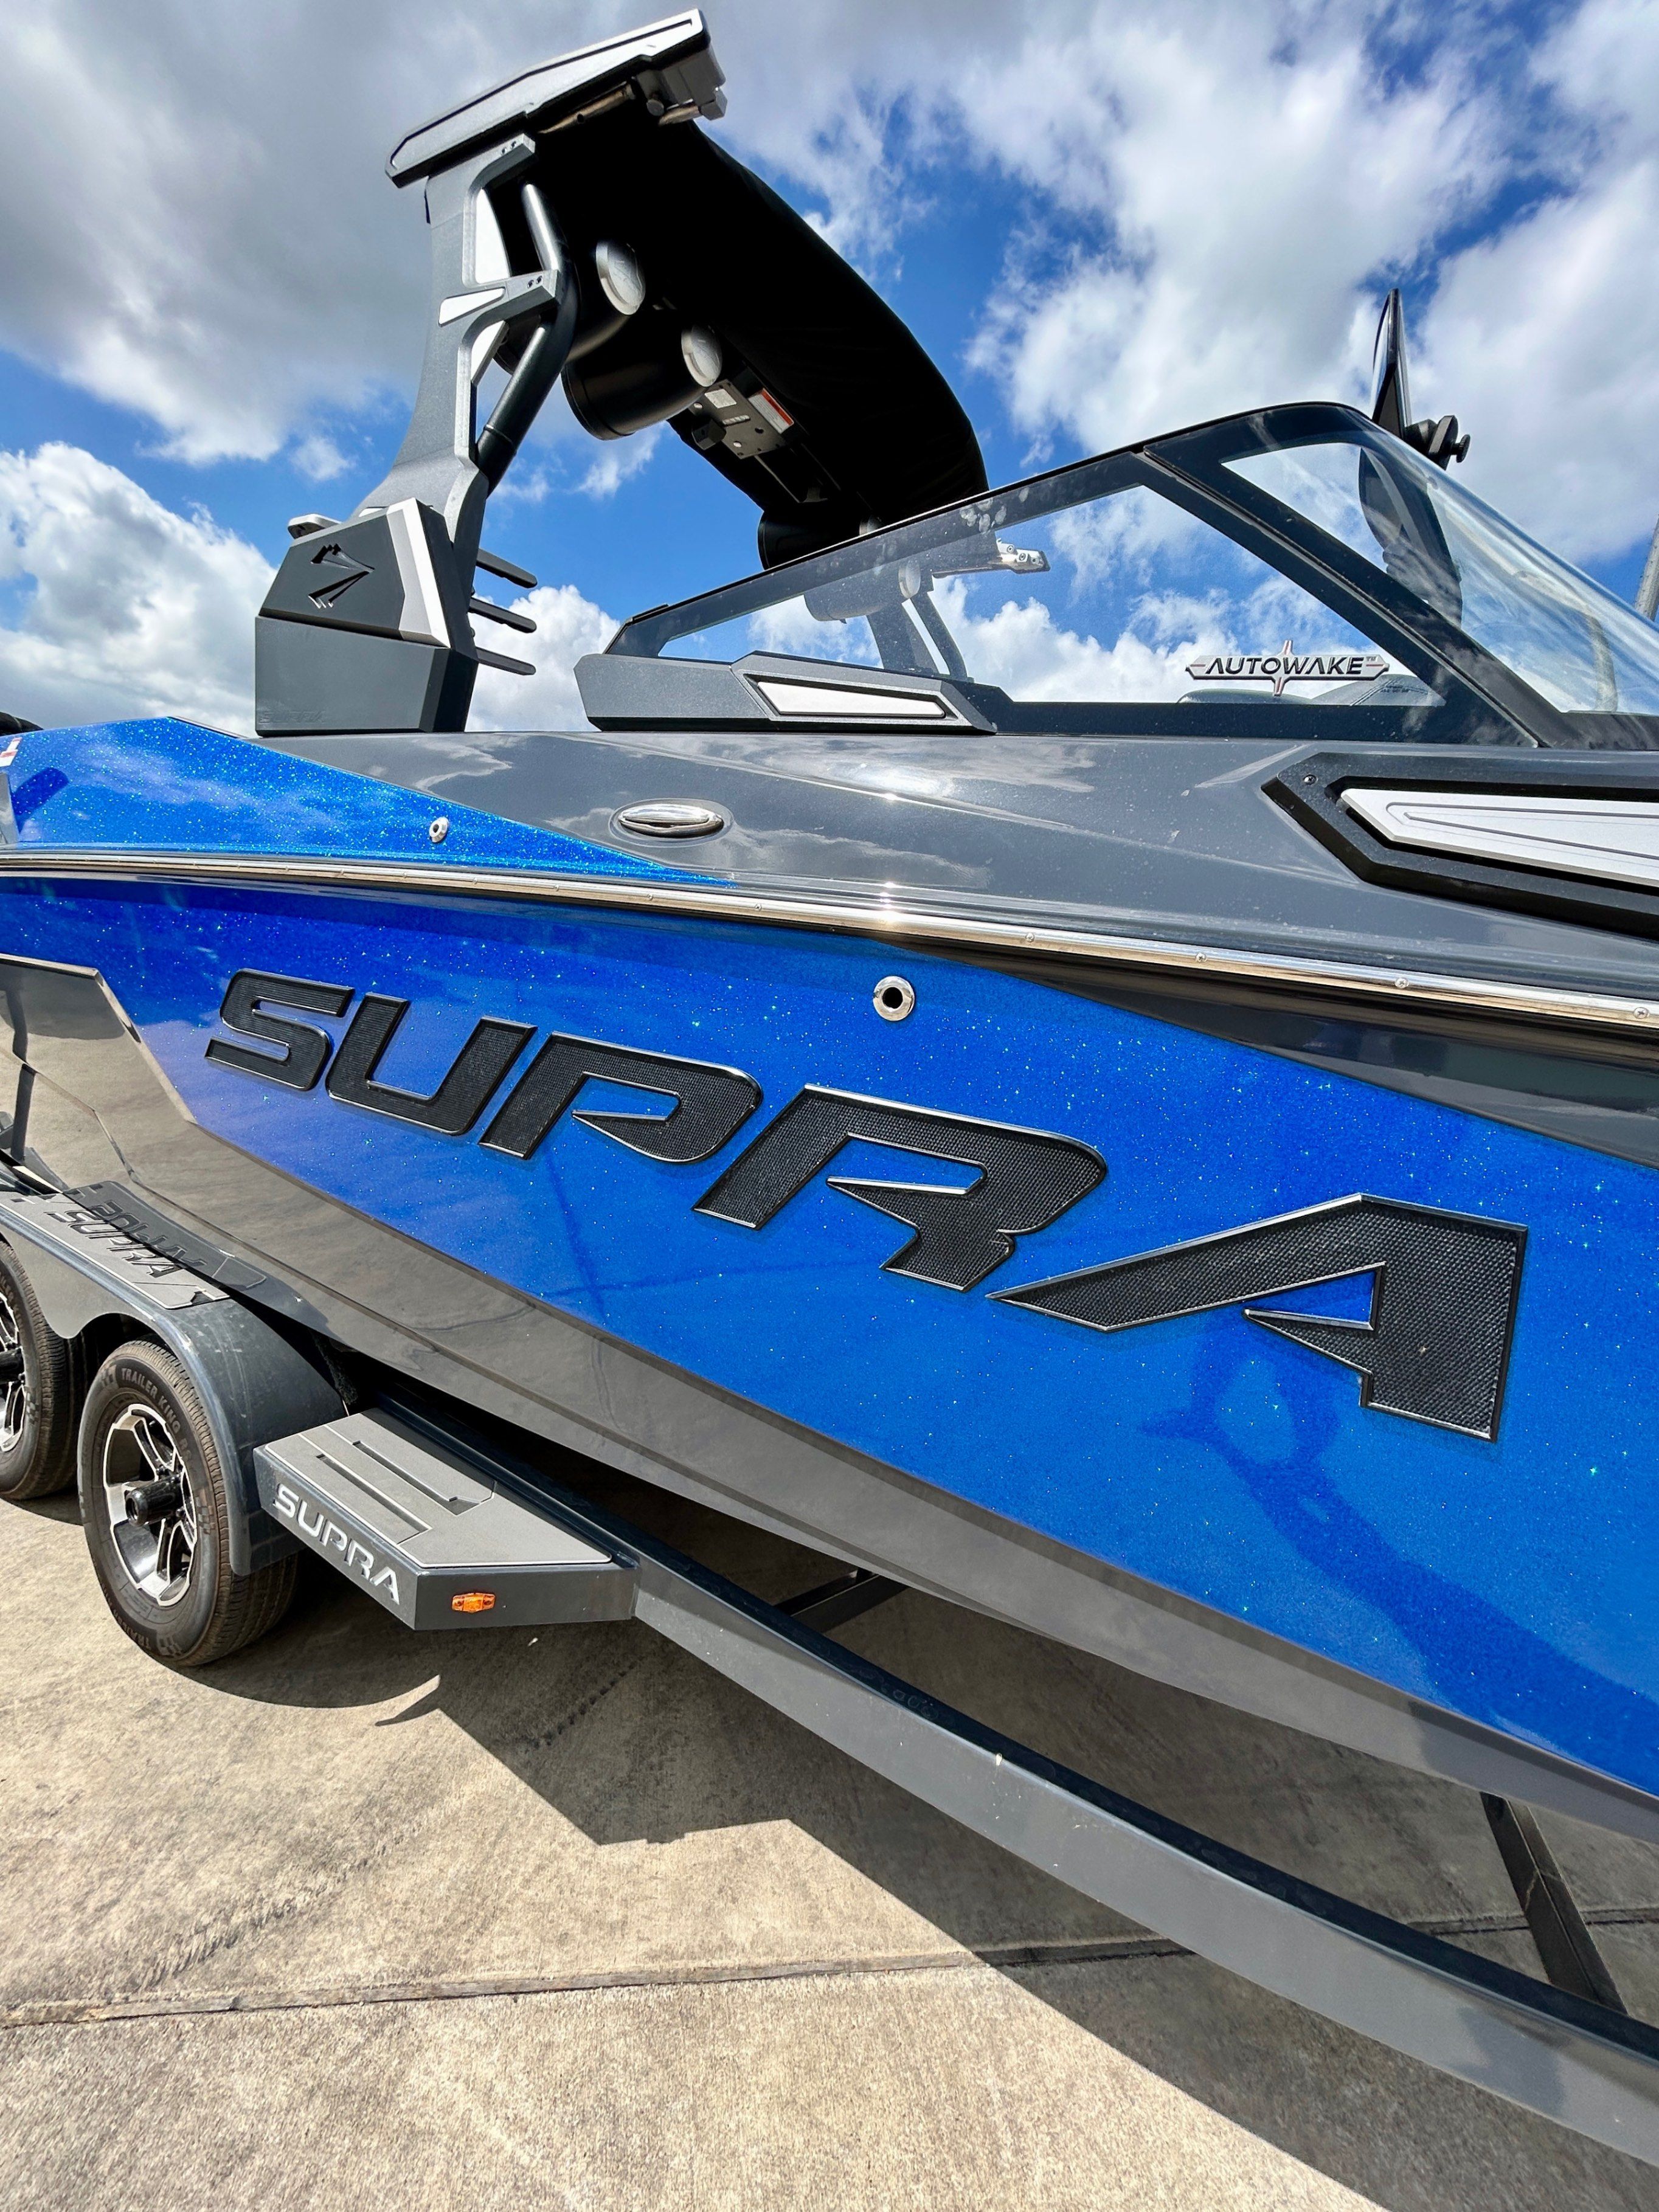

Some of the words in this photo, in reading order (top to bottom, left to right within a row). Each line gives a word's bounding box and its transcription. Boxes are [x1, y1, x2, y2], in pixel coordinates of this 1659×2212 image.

[1205, 657, 1365, 675] AUTOWAKE
[204, 967, 1528, 1442] SUPRA
[44, 1209, 184, 1278] SUPRA
[122, 1367, 158, 1399] TRAILER
[158, 1395, 181, 1434] KING
[273, 1483, 400, 1605] SUPRA
